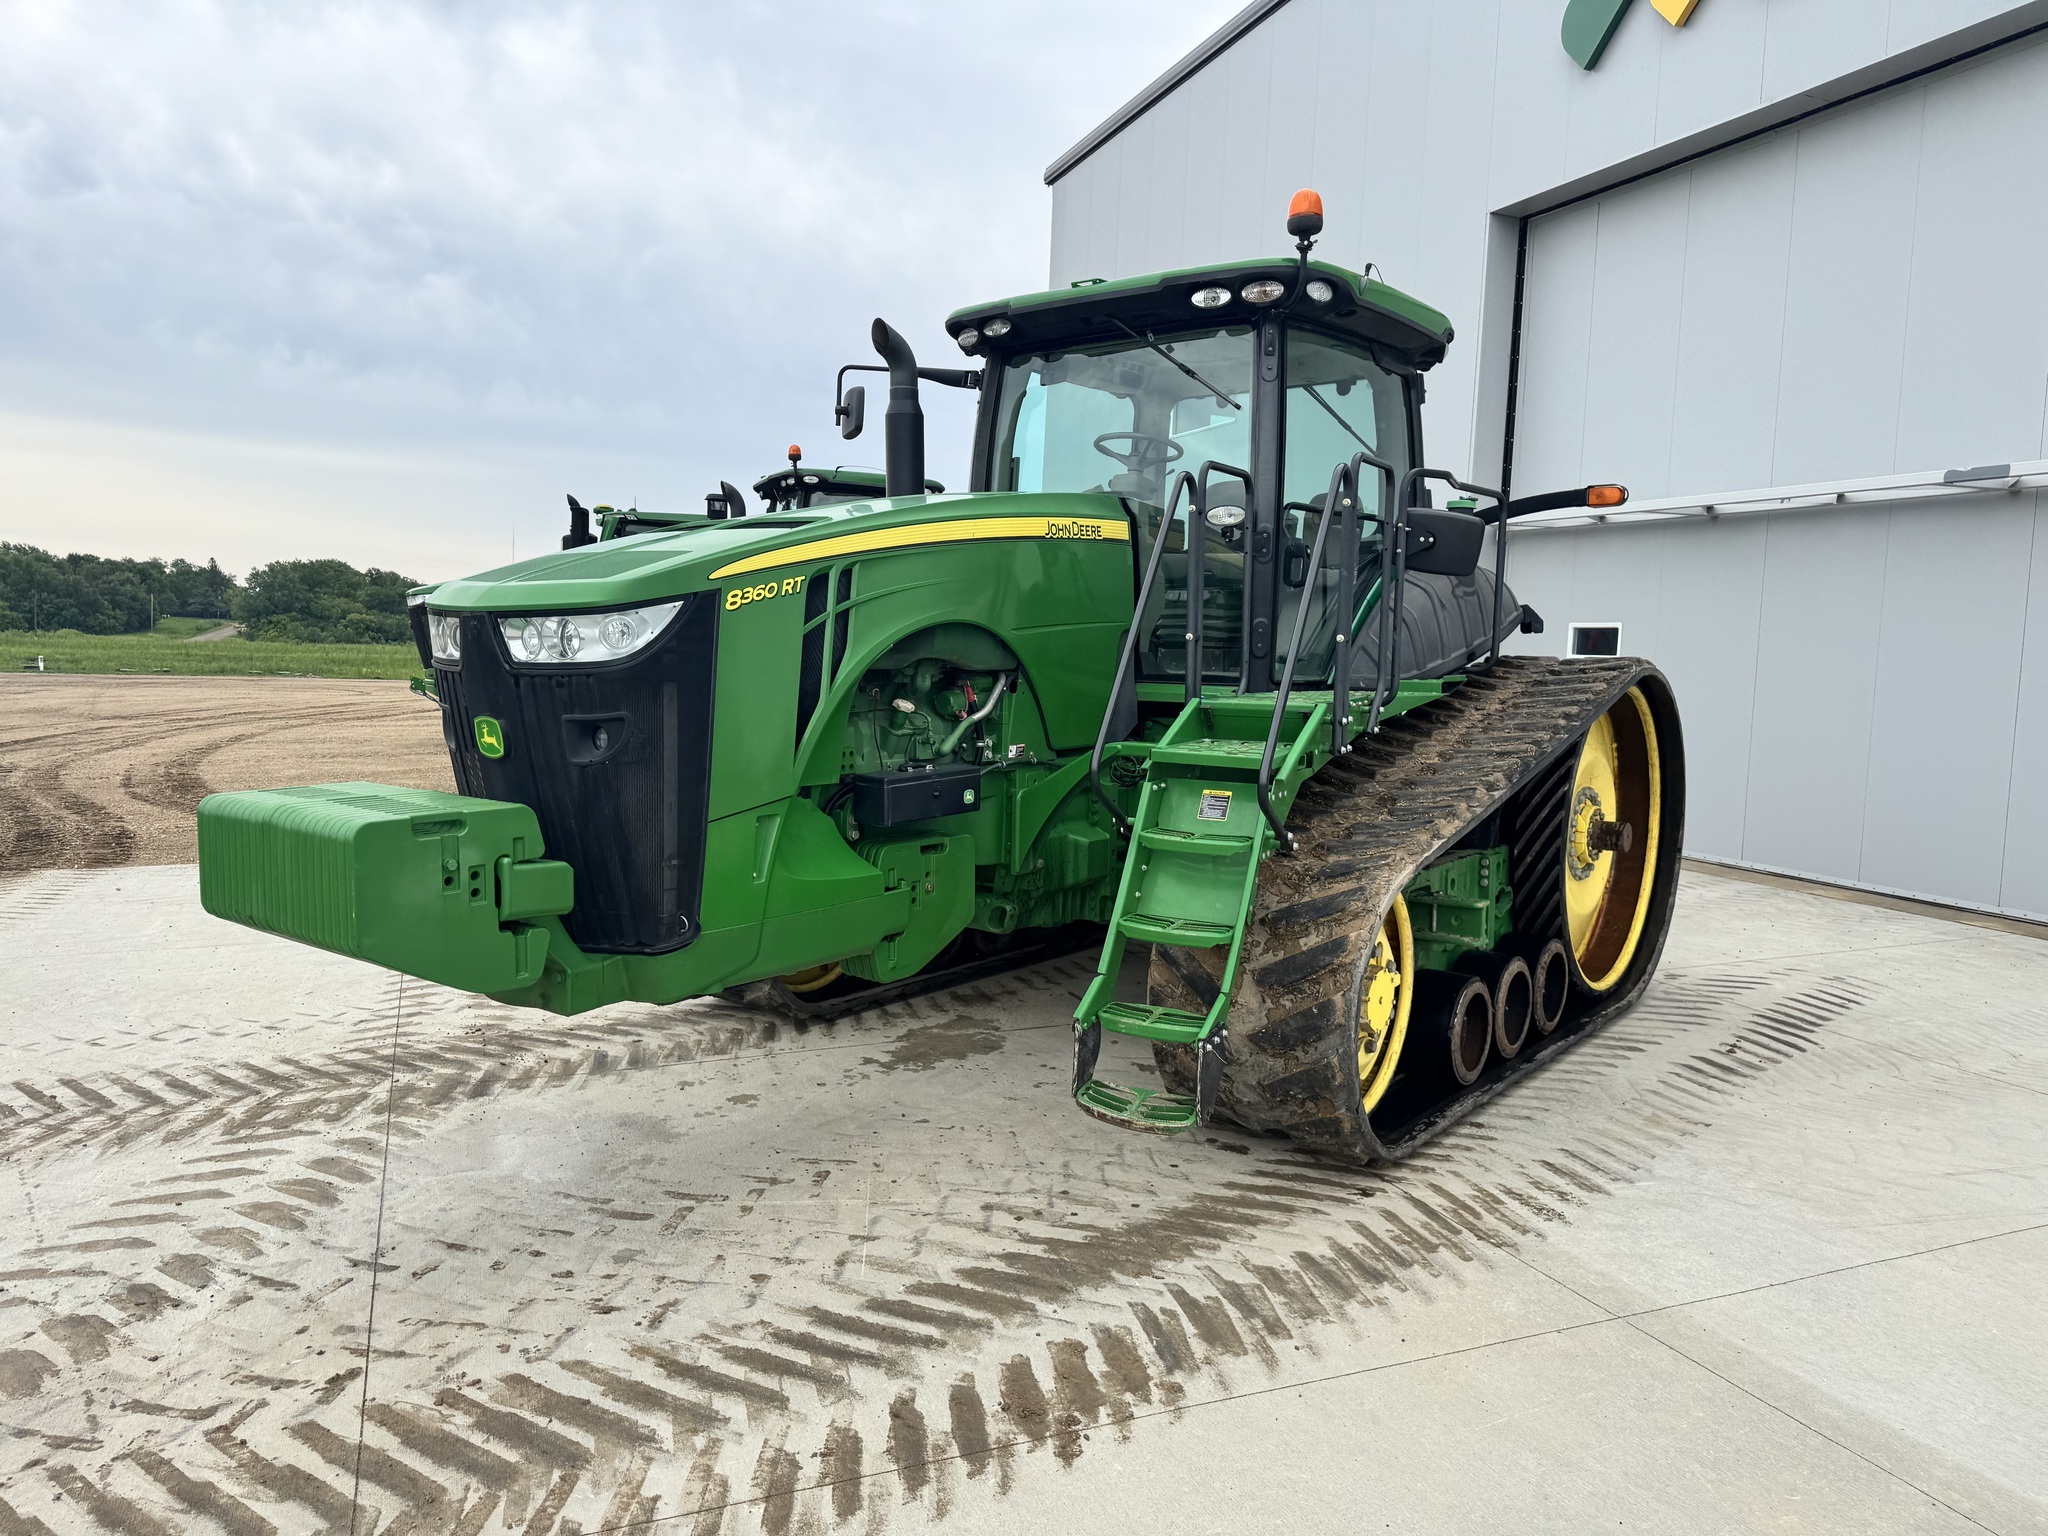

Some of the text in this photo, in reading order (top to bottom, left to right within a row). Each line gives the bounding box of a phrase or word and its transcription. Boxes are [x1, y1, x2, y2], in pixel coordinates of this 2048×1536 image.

[1044, 520, 1103, 538] JOHN DEERE
[725, 575, 806, 611] 8360 RT
